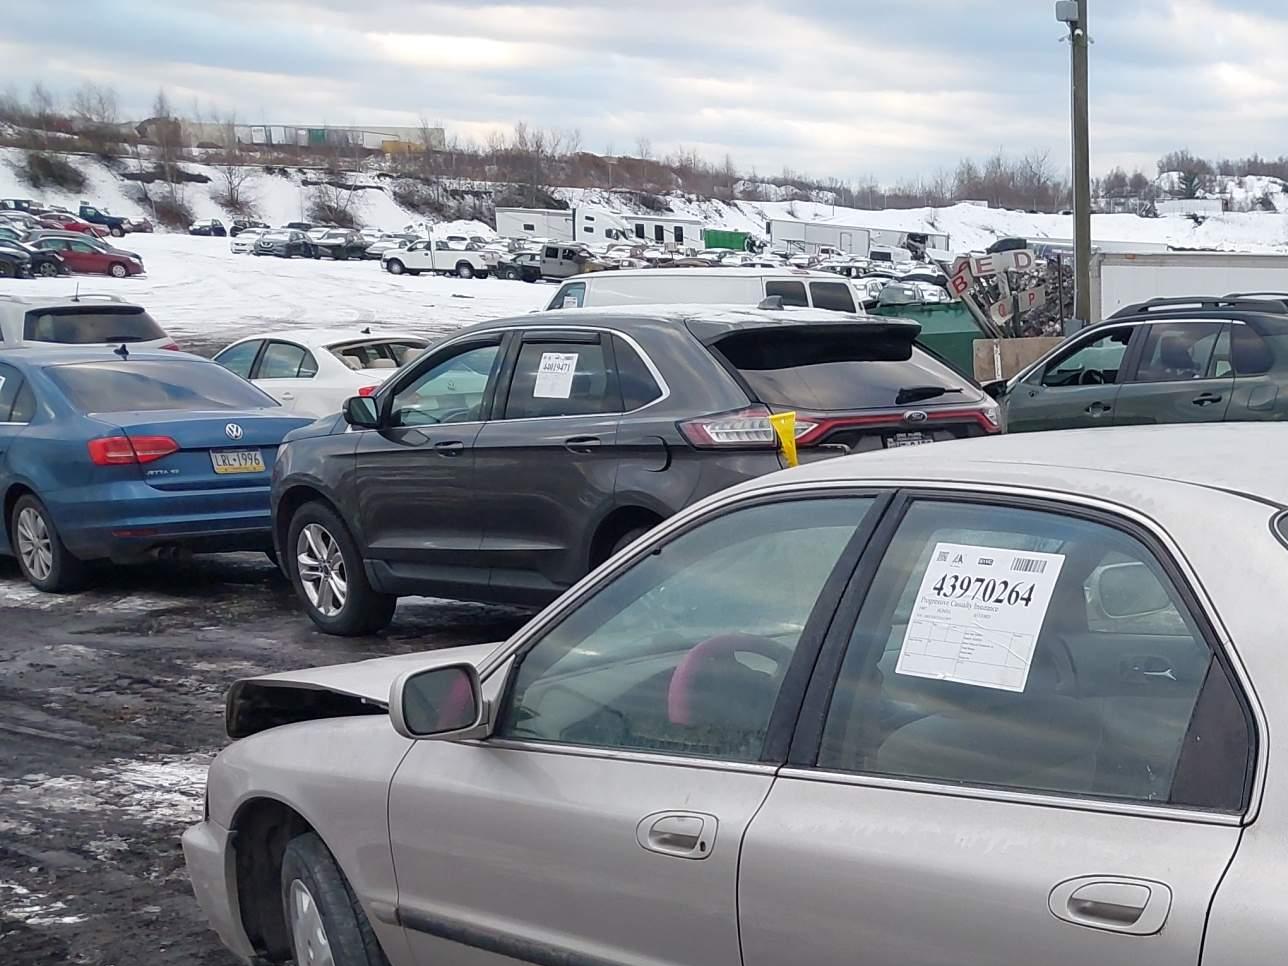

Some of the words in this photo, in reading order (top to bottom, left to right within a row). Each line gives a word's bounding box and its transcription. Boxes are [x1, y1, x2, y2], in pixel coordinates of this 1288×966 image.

[975, 256, 995, 273] E
[1013, 251, 1032, 269] D
[952, 276, 968, 294] B
[932, 573, 1036, 607] 43970264
